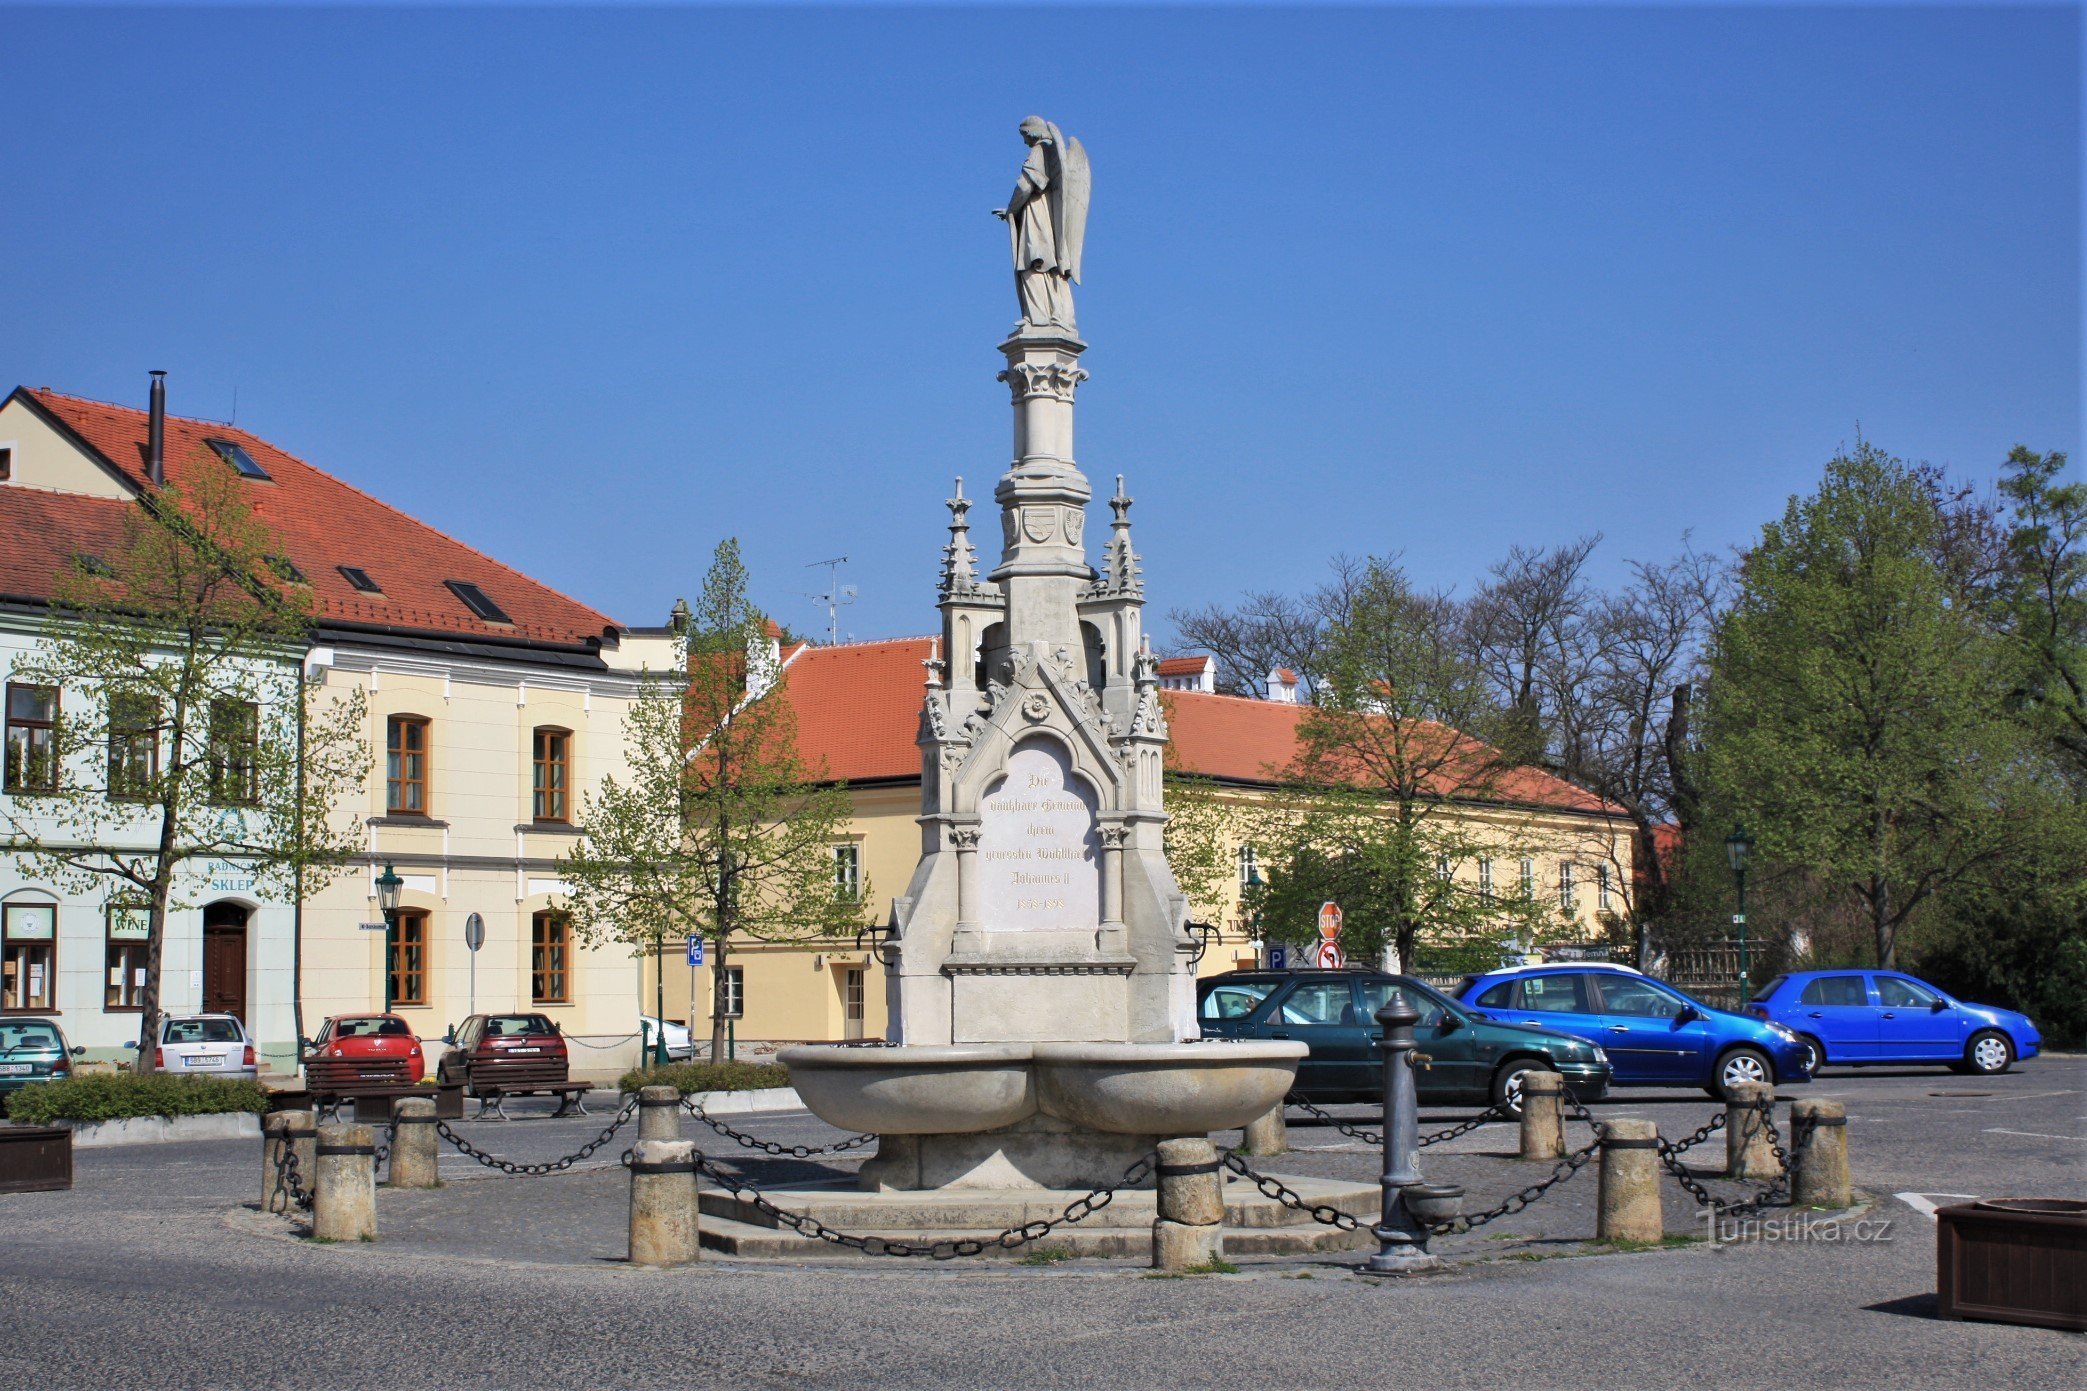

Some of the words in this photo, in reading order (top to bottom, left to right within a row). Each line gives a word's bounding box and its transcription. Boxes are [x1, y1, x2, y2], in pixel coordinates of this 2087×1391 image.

[1028, 773, 1048, 788] Die
[211, 878, 255, 891] SKLEP
[114, 919, 148, 931] WINE
[1320, 914, 1340, 929] STOP
[1271, 951, 1282, 968] P
